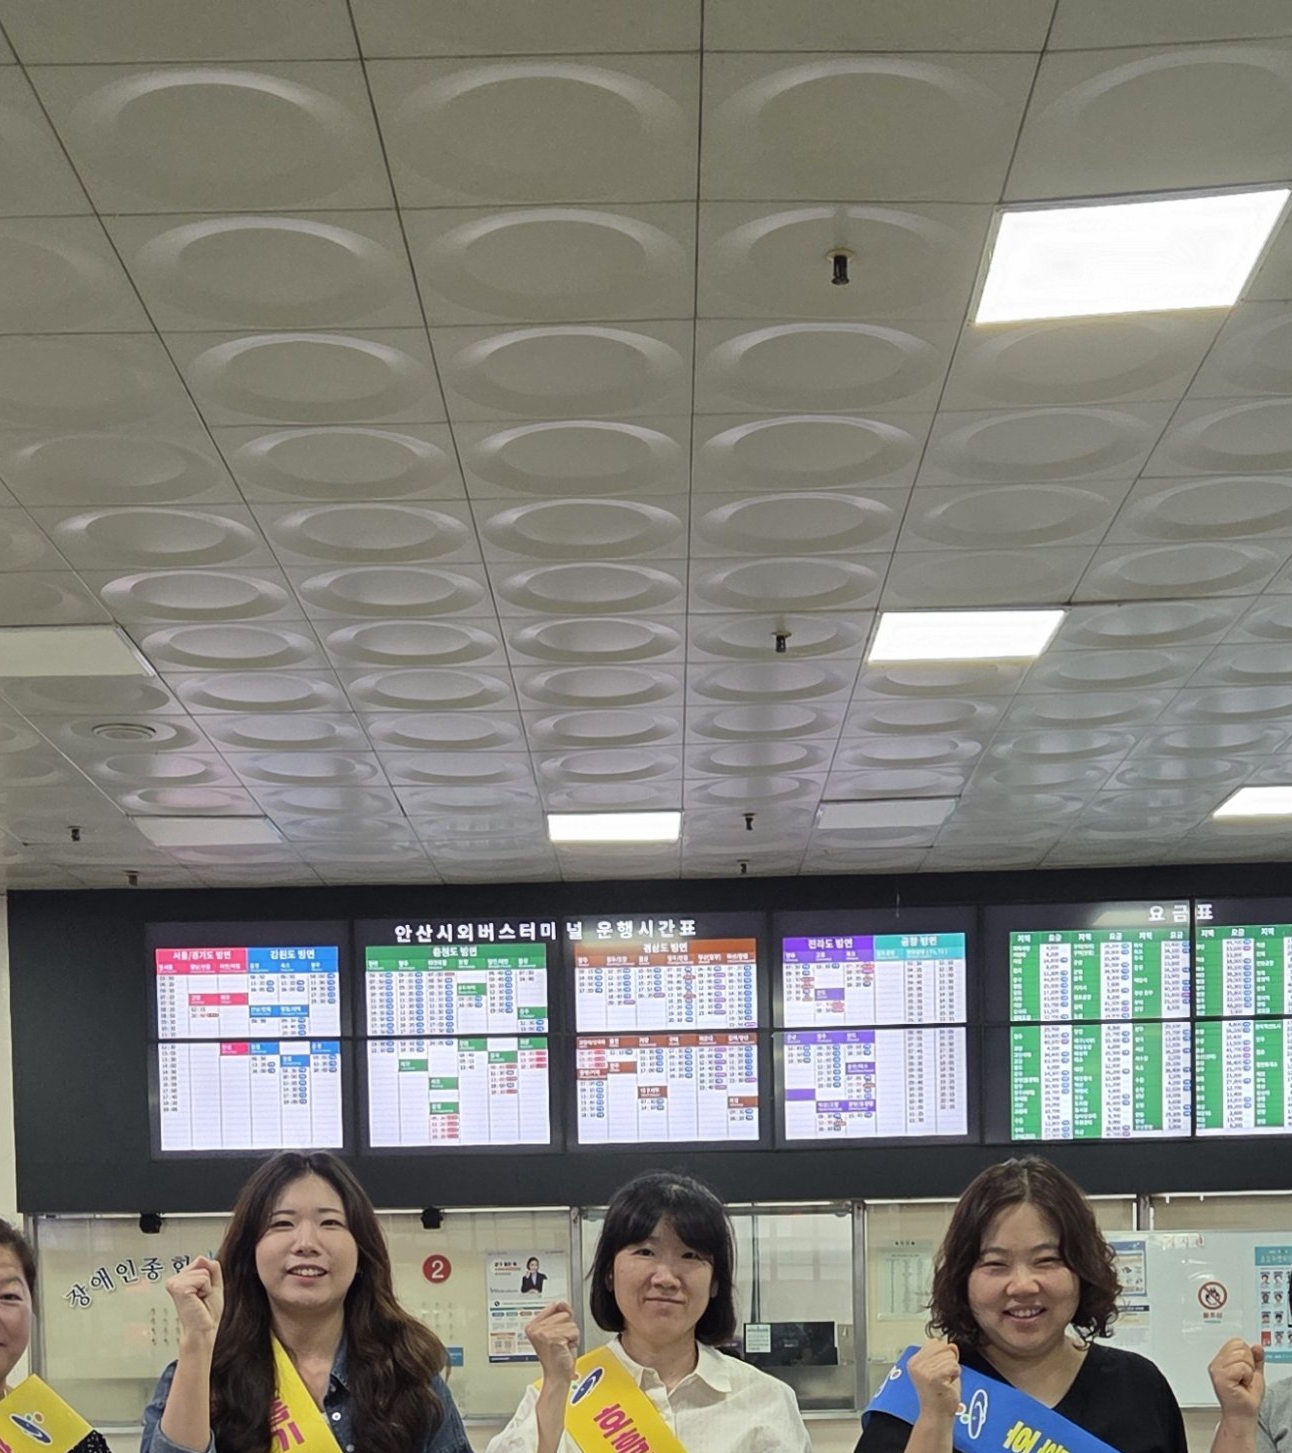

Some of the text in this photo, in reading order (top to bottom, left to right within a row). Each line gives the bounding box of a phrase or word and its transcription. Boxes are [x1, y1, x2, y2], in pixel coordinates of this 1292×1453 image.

[394, 919, 697, 943] 안산시외버스터미널 운행시간표
[431, 1259, 445, 1279] 2
